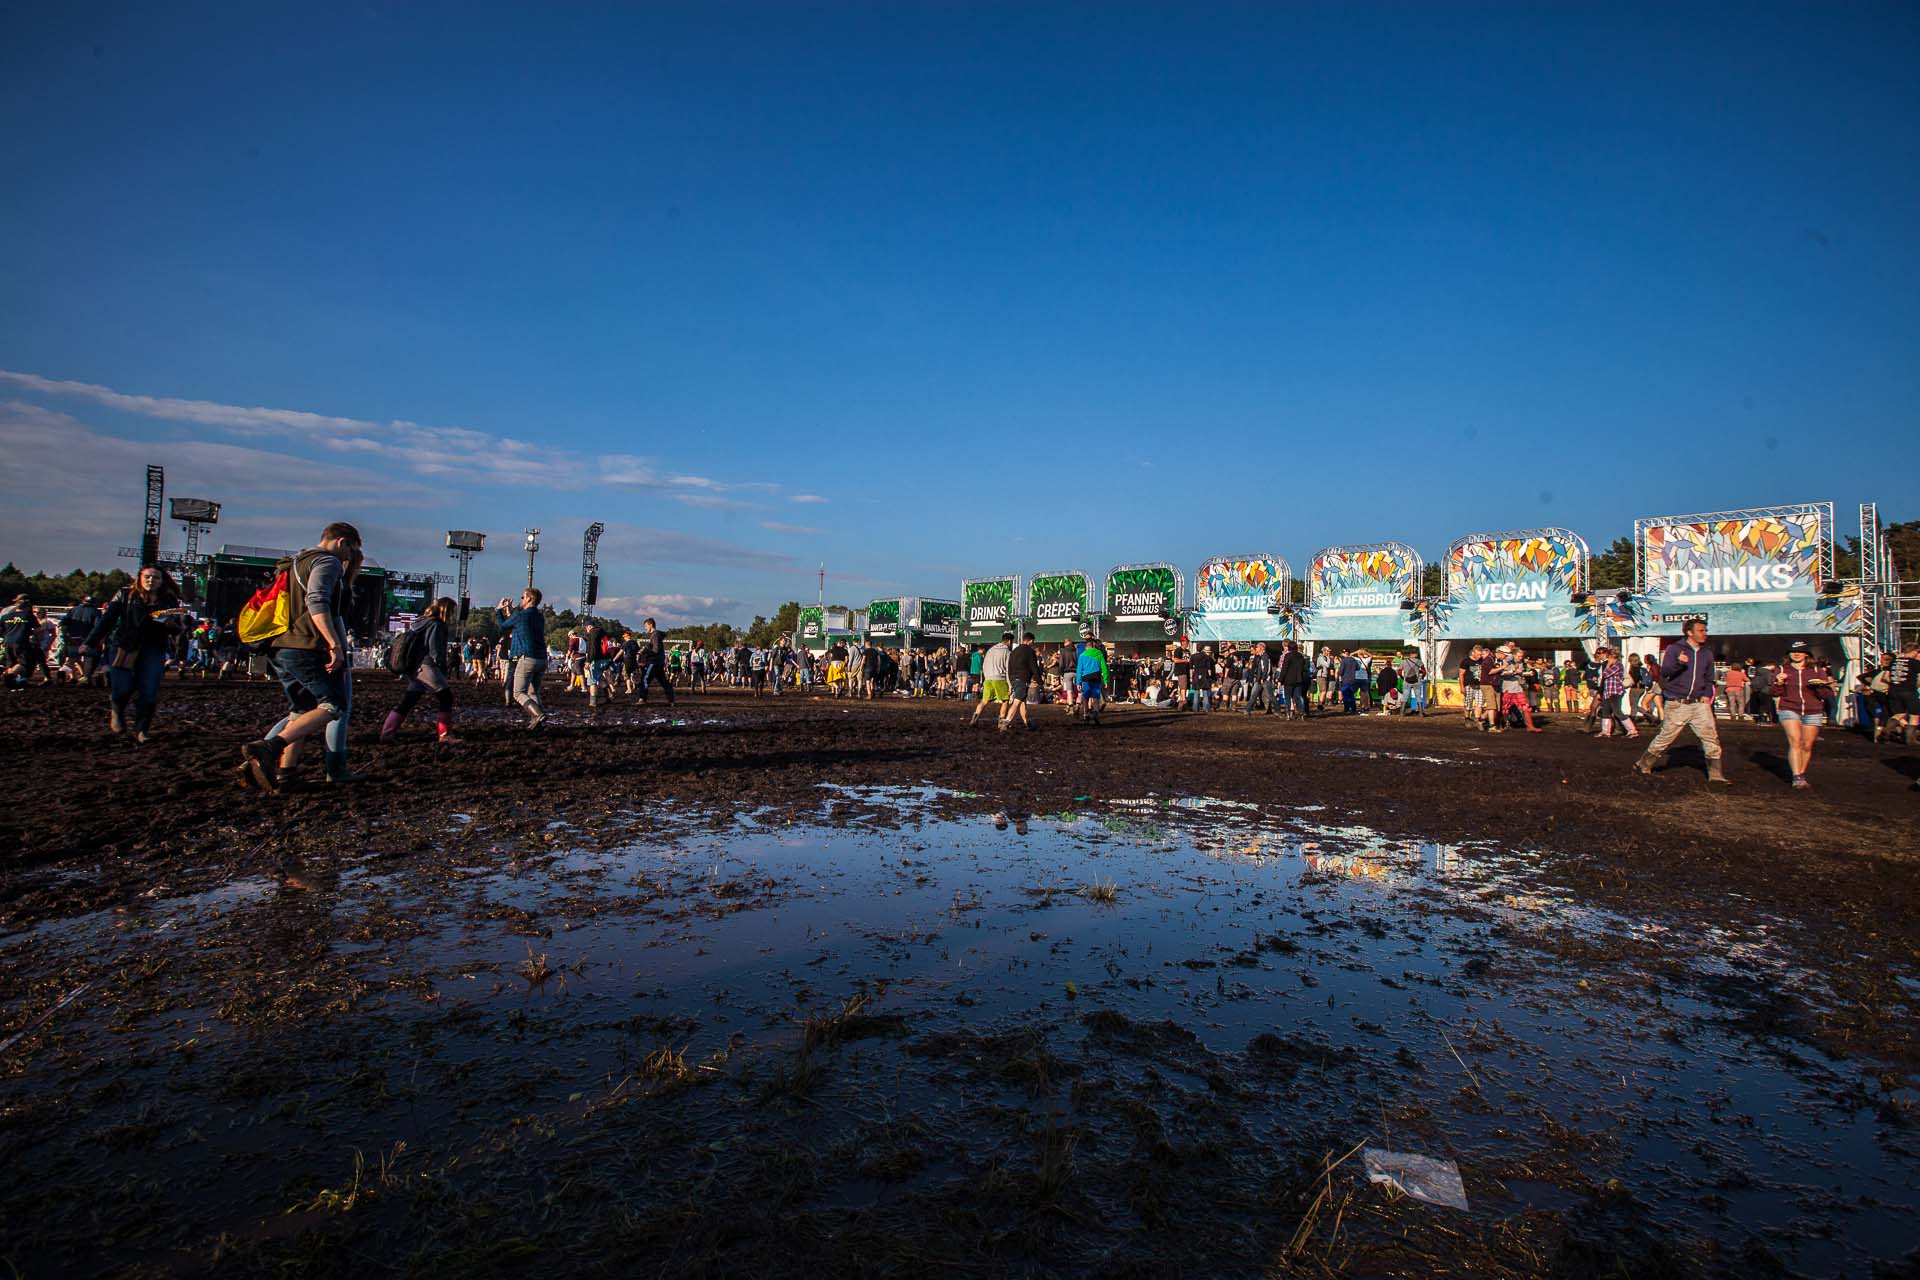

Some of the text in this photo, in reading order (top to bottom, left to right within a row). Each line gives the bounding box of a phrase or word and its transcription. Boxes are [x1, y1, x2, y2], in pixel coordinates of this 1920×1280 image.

[1668, 564, 1794, 594] DRINKS
[1115, 592, 1168, 606] PFANNEN-
[1475, 581, 1548, 602] VEGAN
[1204, 595, 1275, 612] SMOOTHIES
[1321, 592, 1402, 608] FLADENBROT
[971, 606, 1006, 621] DRINKS
[1036, 601, 1079, 618] CRÊPES
[1121, 605, 1160, 615] SCHMAUS
[1664, 613, 1707, 622] BECK'S
